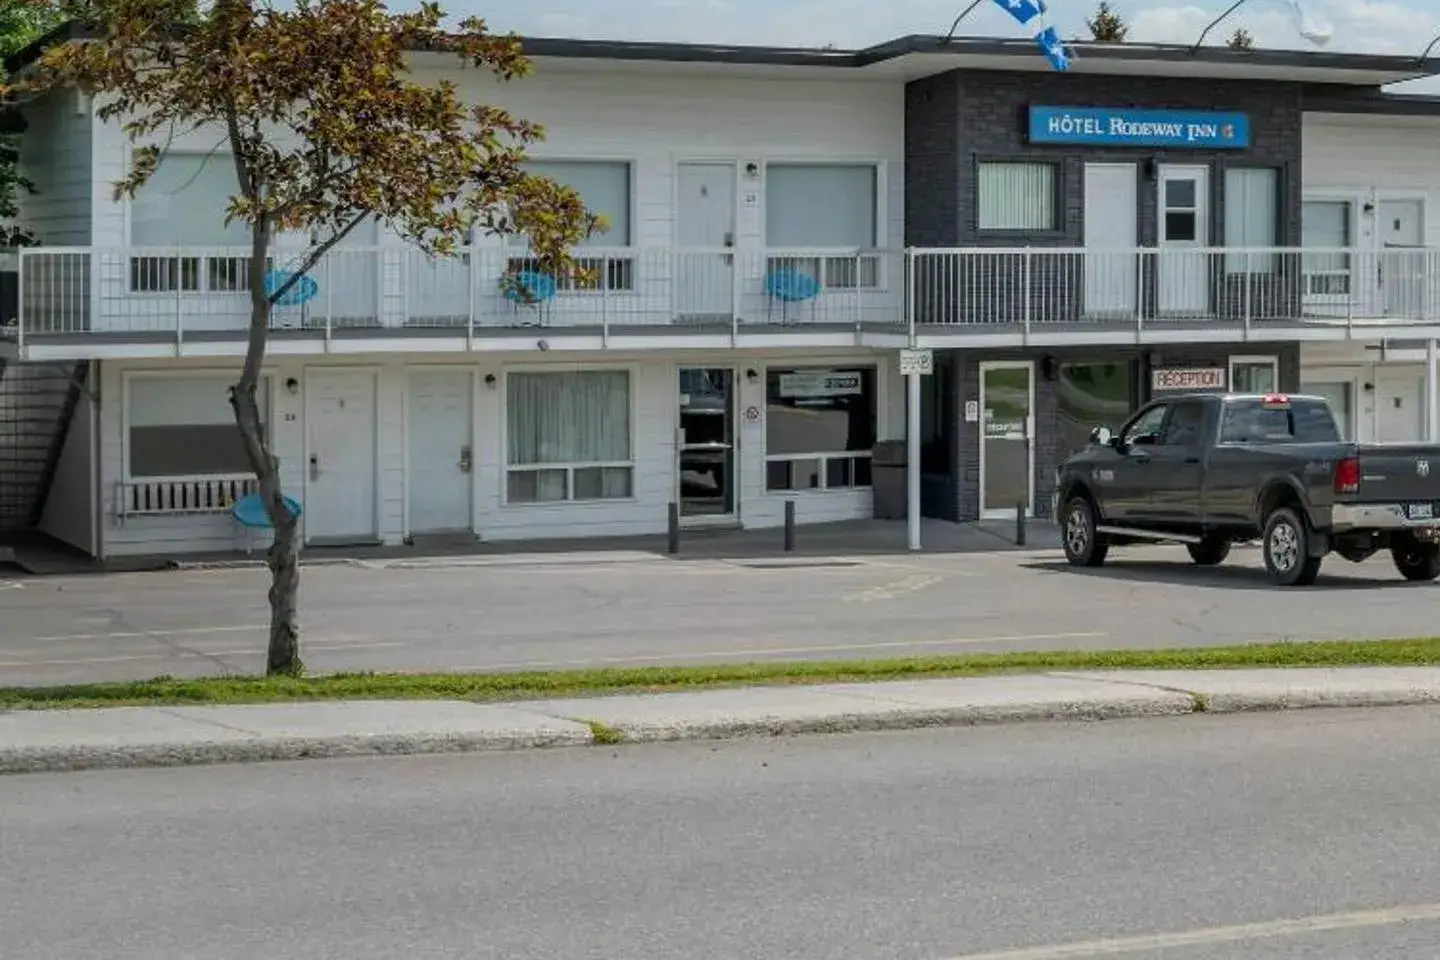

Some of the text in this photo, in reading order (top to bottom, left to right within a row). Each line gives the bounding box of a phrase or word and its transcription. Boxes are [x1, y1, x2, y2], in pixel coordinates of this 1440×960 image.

[1048, 114, 1217, 141] HÔTEL RODEWAY INN
